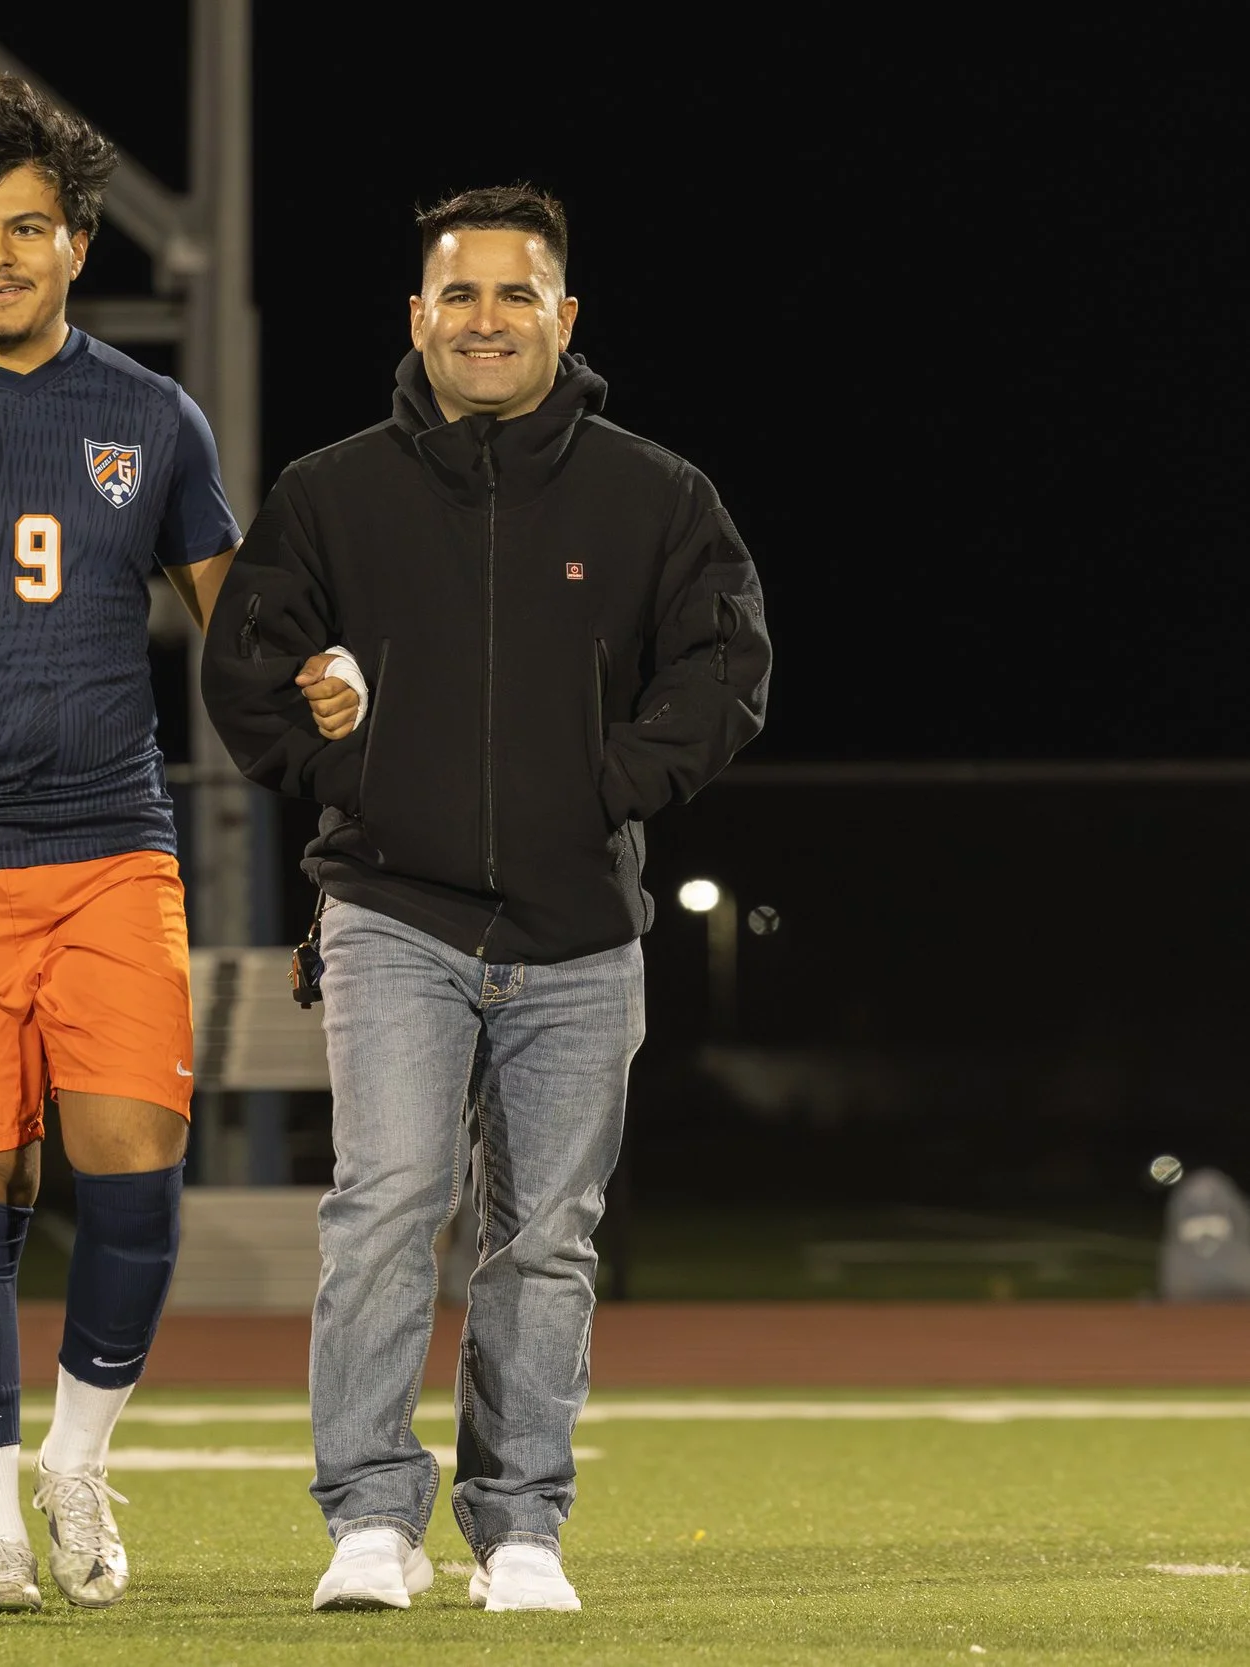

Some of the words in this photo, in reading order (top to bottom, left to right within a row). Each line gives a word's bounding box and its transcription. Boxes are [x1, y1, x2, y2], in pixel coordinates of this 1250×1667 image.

[94, 455, 113, 475] GRIZZLY
[117, 458, 132, 487] G
[14, 513, 62, 603] 9
